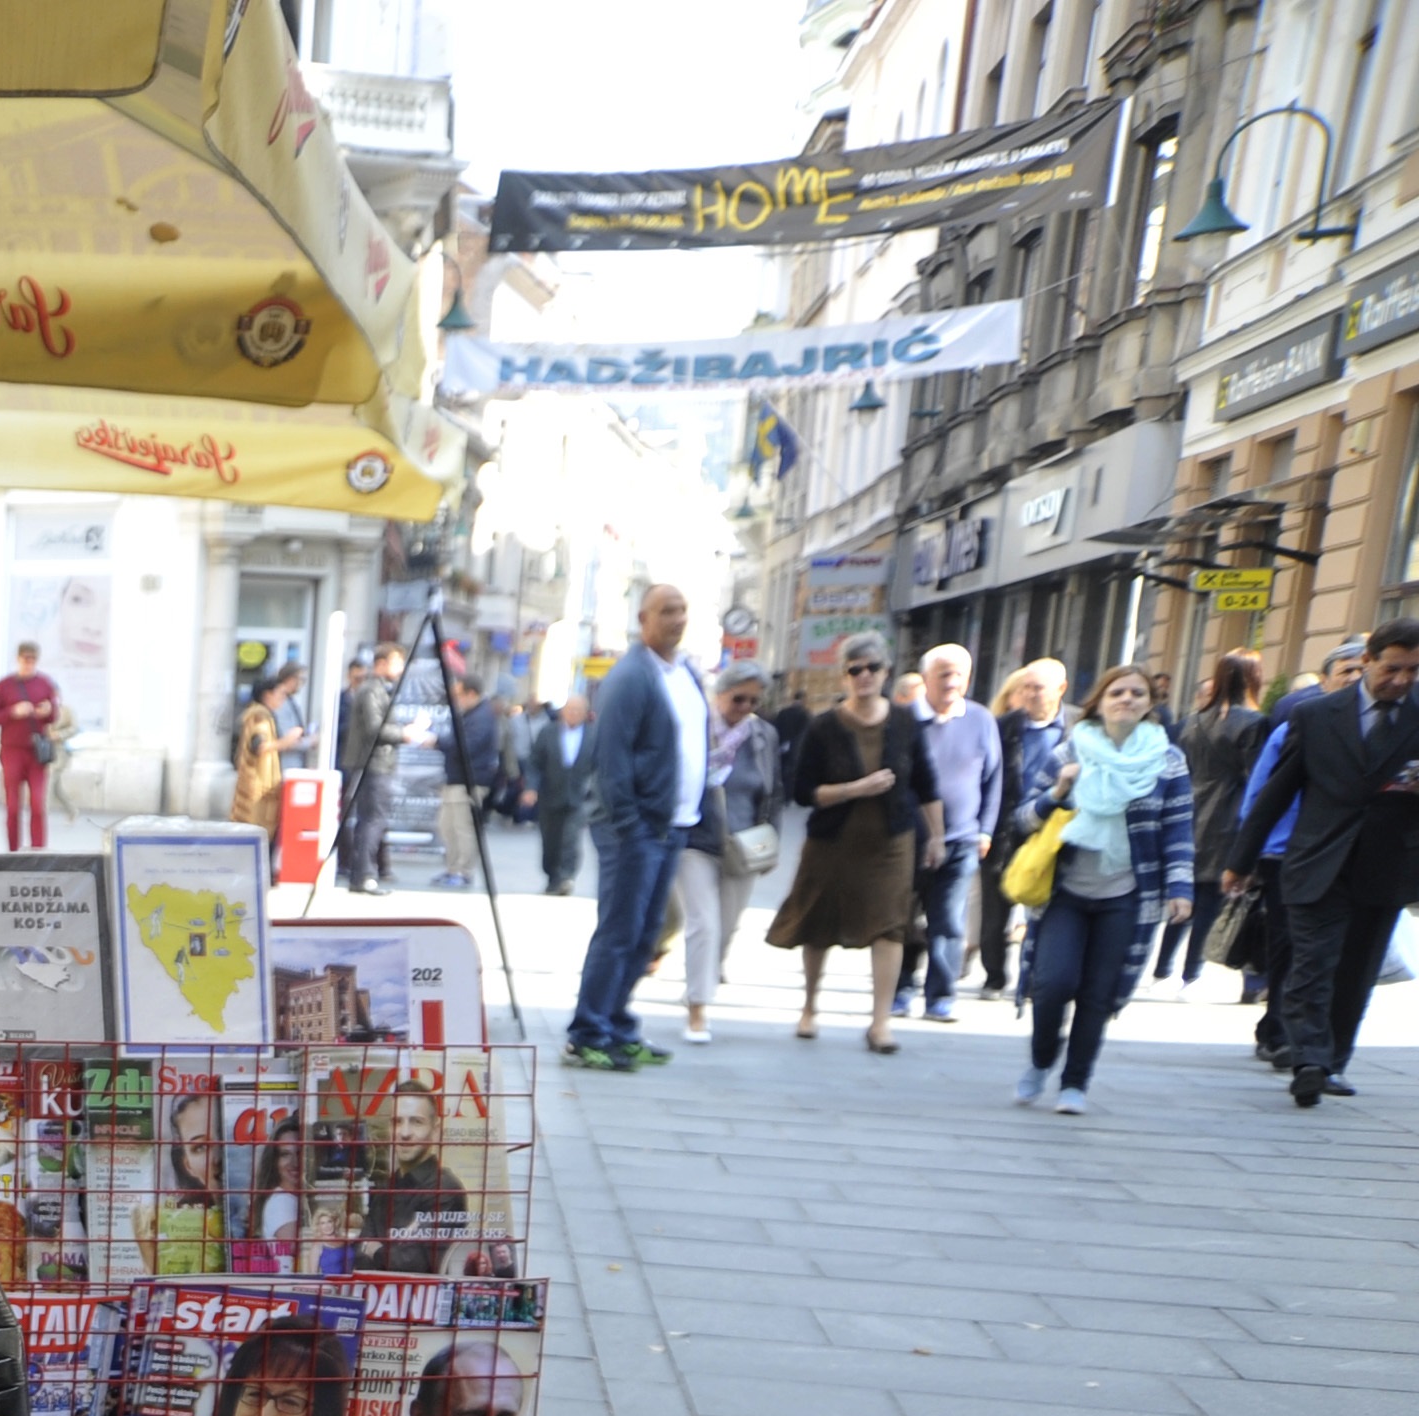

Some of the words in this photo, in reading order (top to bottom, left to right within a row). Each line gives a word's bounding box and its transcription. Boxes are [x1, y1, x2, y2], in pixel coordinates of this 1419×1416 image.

[693, 165, 853, 234] HOME
[500, 325, 943, 385] HADŽIBAJRIĆ
[1225, 596, 1258, 606] 0-24
[10, 886, 63, 898] BOSNA
[1, 899, 91, 914] KANDŽAMA
[173, 1295, 293, 1334] start
